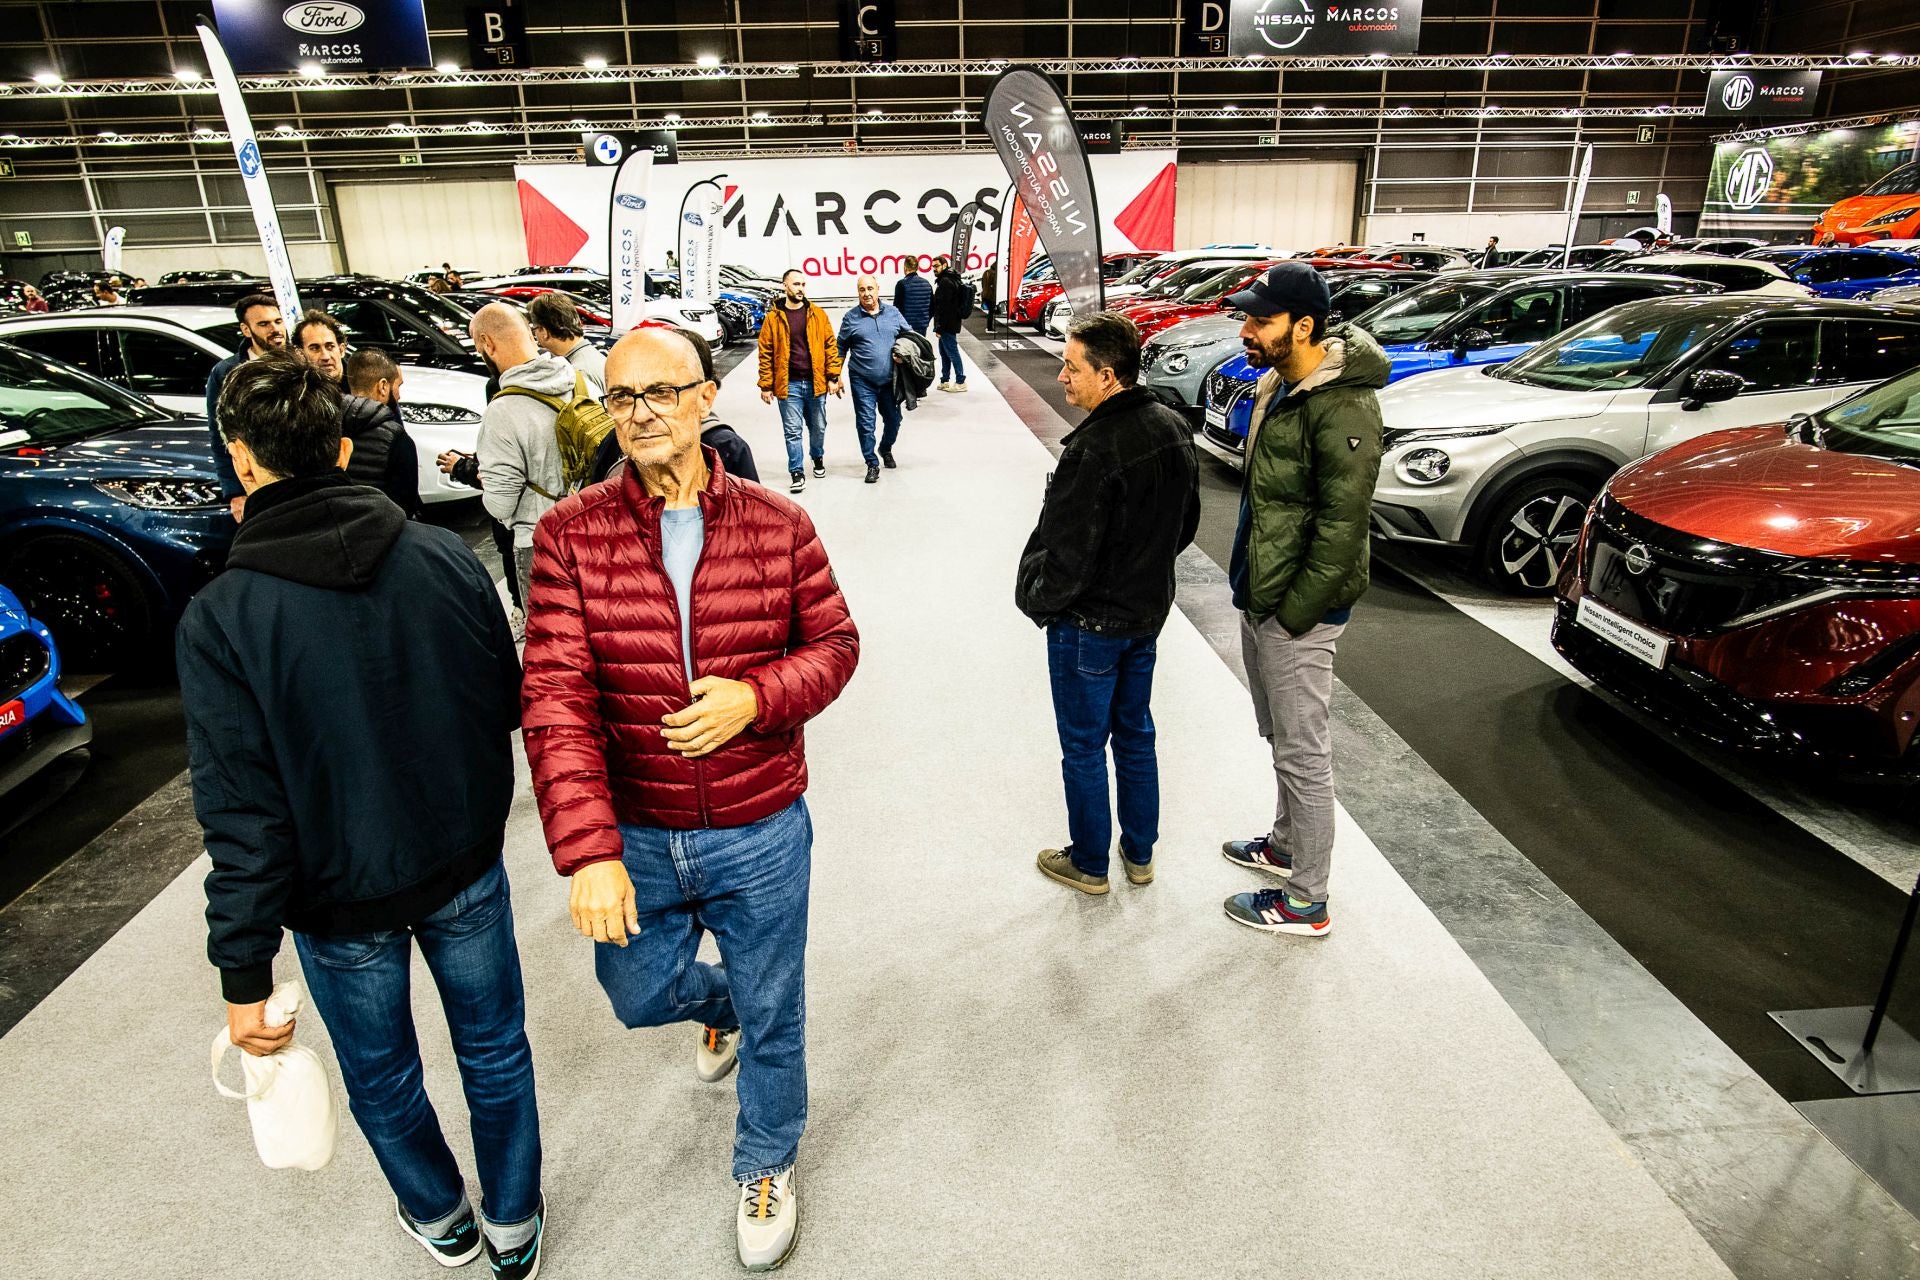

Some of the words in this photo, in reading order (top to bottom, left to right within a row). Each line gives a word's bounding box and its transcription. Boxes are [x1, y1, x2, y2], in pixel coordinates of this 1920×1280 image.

[301, 6, 348, 28] Ford
[857, 5, 878, 35] C
[1202, 2, 1224, 31] D
[1254, 14, 1315, 26] NISSAN
[1326, 6, 1399, 22] MARCOS
[485, 13, 504, 43] B
[1348, 22, 1398, 32] automoción
[299, 43, 361, 56] MARCOS
[871, 42, 878, 54] 3
[1213, 38, 1221, 50] 3
[501, 50, 510, 61] 3
[1725, 78, 1752, 108] MG
[1760, 85, 1805, 96] MARCOS
[1081, 132, 1112, 140] ARCOS
[1728, 153, 1770, 205] MG
[620, 195, 644, 209] Ford
[620, 228, 632, 305] MARCOS
[1584, 605, 1603, 621] Nissan
[1603, 615, 1634, 638] Intelligent
[1633, 632, 1656, 650] Choice
[457, 1220, 471, 1235] NIKE
[500, 1255, 518, 1266] NIKE
